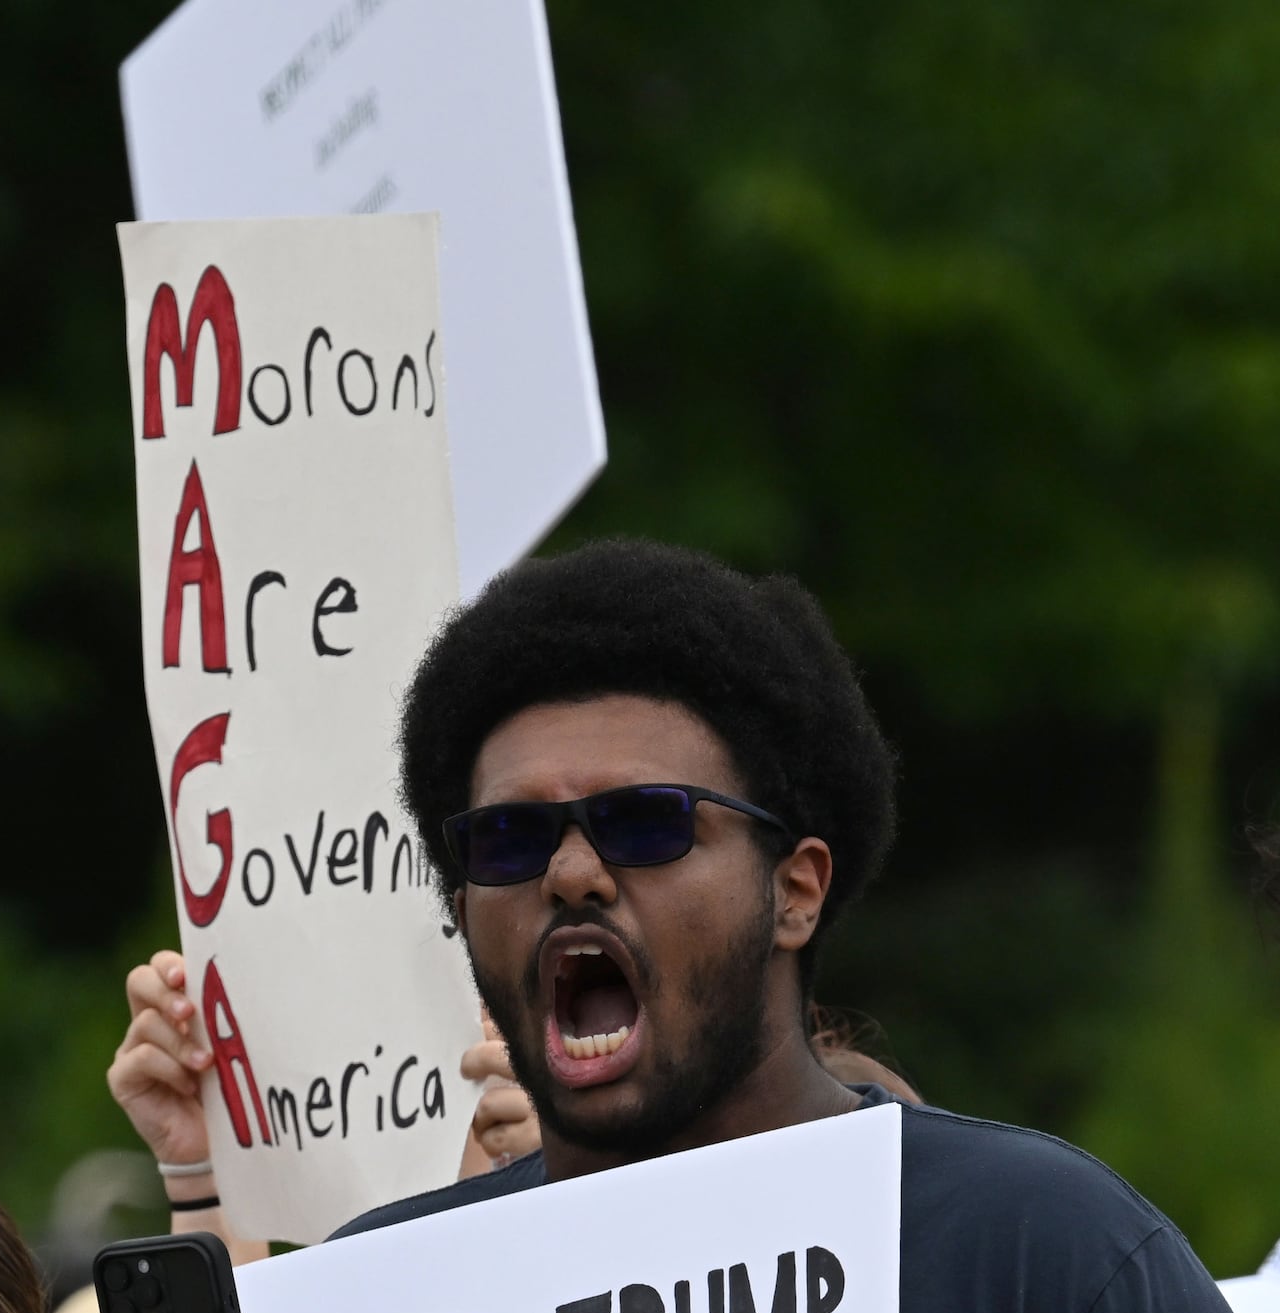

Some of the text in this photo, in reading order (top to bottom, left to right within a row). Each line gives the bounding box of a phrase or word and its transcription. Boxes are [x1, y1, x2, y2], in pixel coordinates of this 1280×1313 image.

[142, 264, 436, 440] Morons
[162, 458, 359, 676] Are
[203, 956, 445, 1150] America
